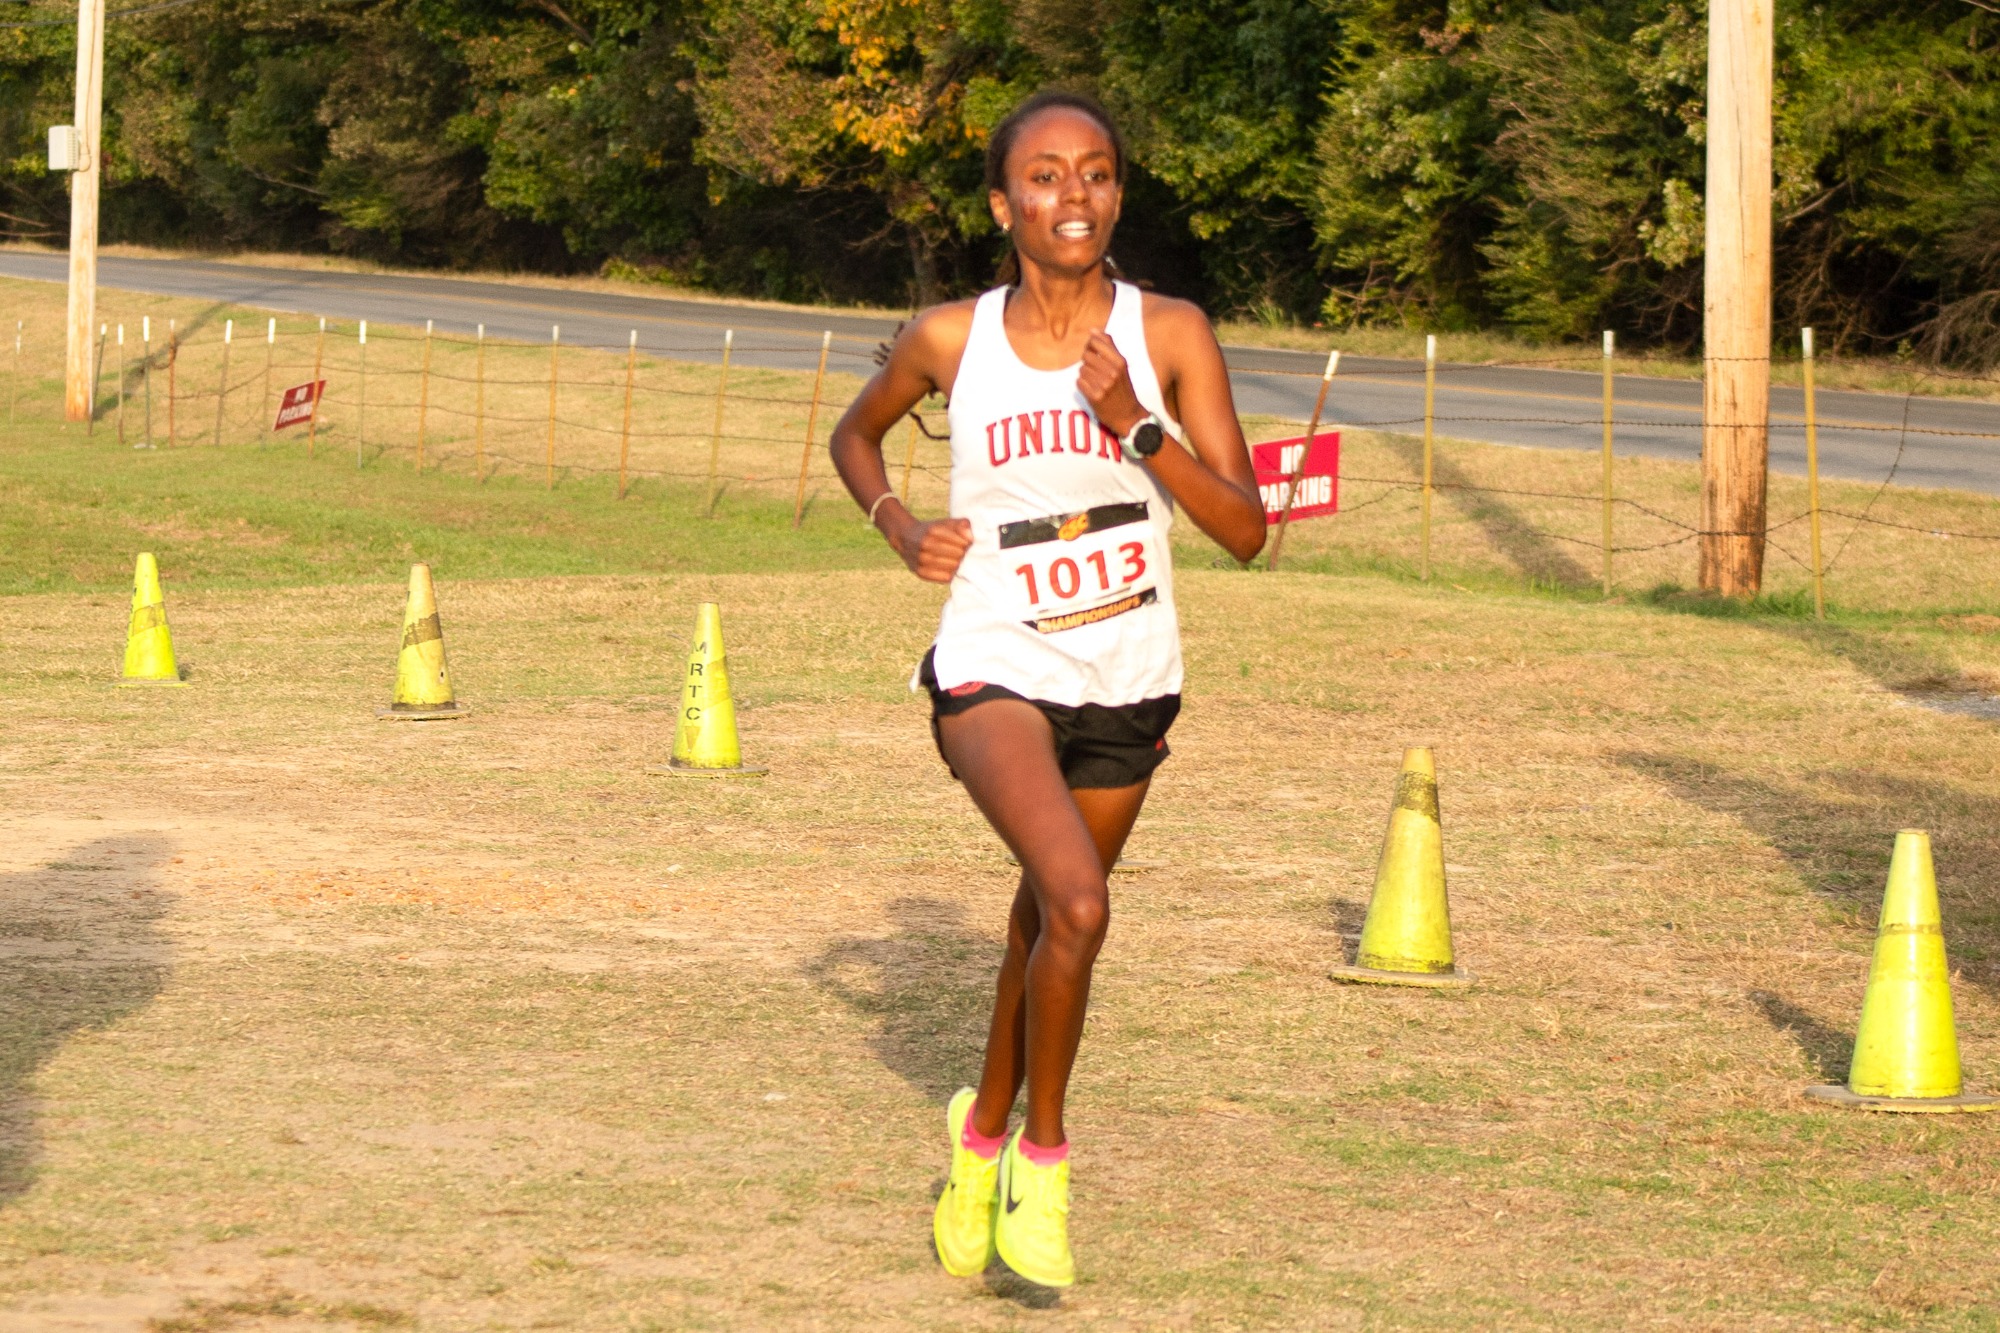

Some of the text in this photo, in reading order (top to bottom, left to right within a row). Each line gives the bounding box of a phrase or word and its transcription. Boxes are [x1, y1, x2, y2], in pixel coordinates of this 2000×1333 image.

[986, 410, 1122, 467] UNION
[1281, 444, 1305, 474] NO
[1015, 541, 1147, 605] 1013
[1037, 595, 1141, 634] CHAMPIONSHIPS
[685, 641, 707, 721] MRTC
